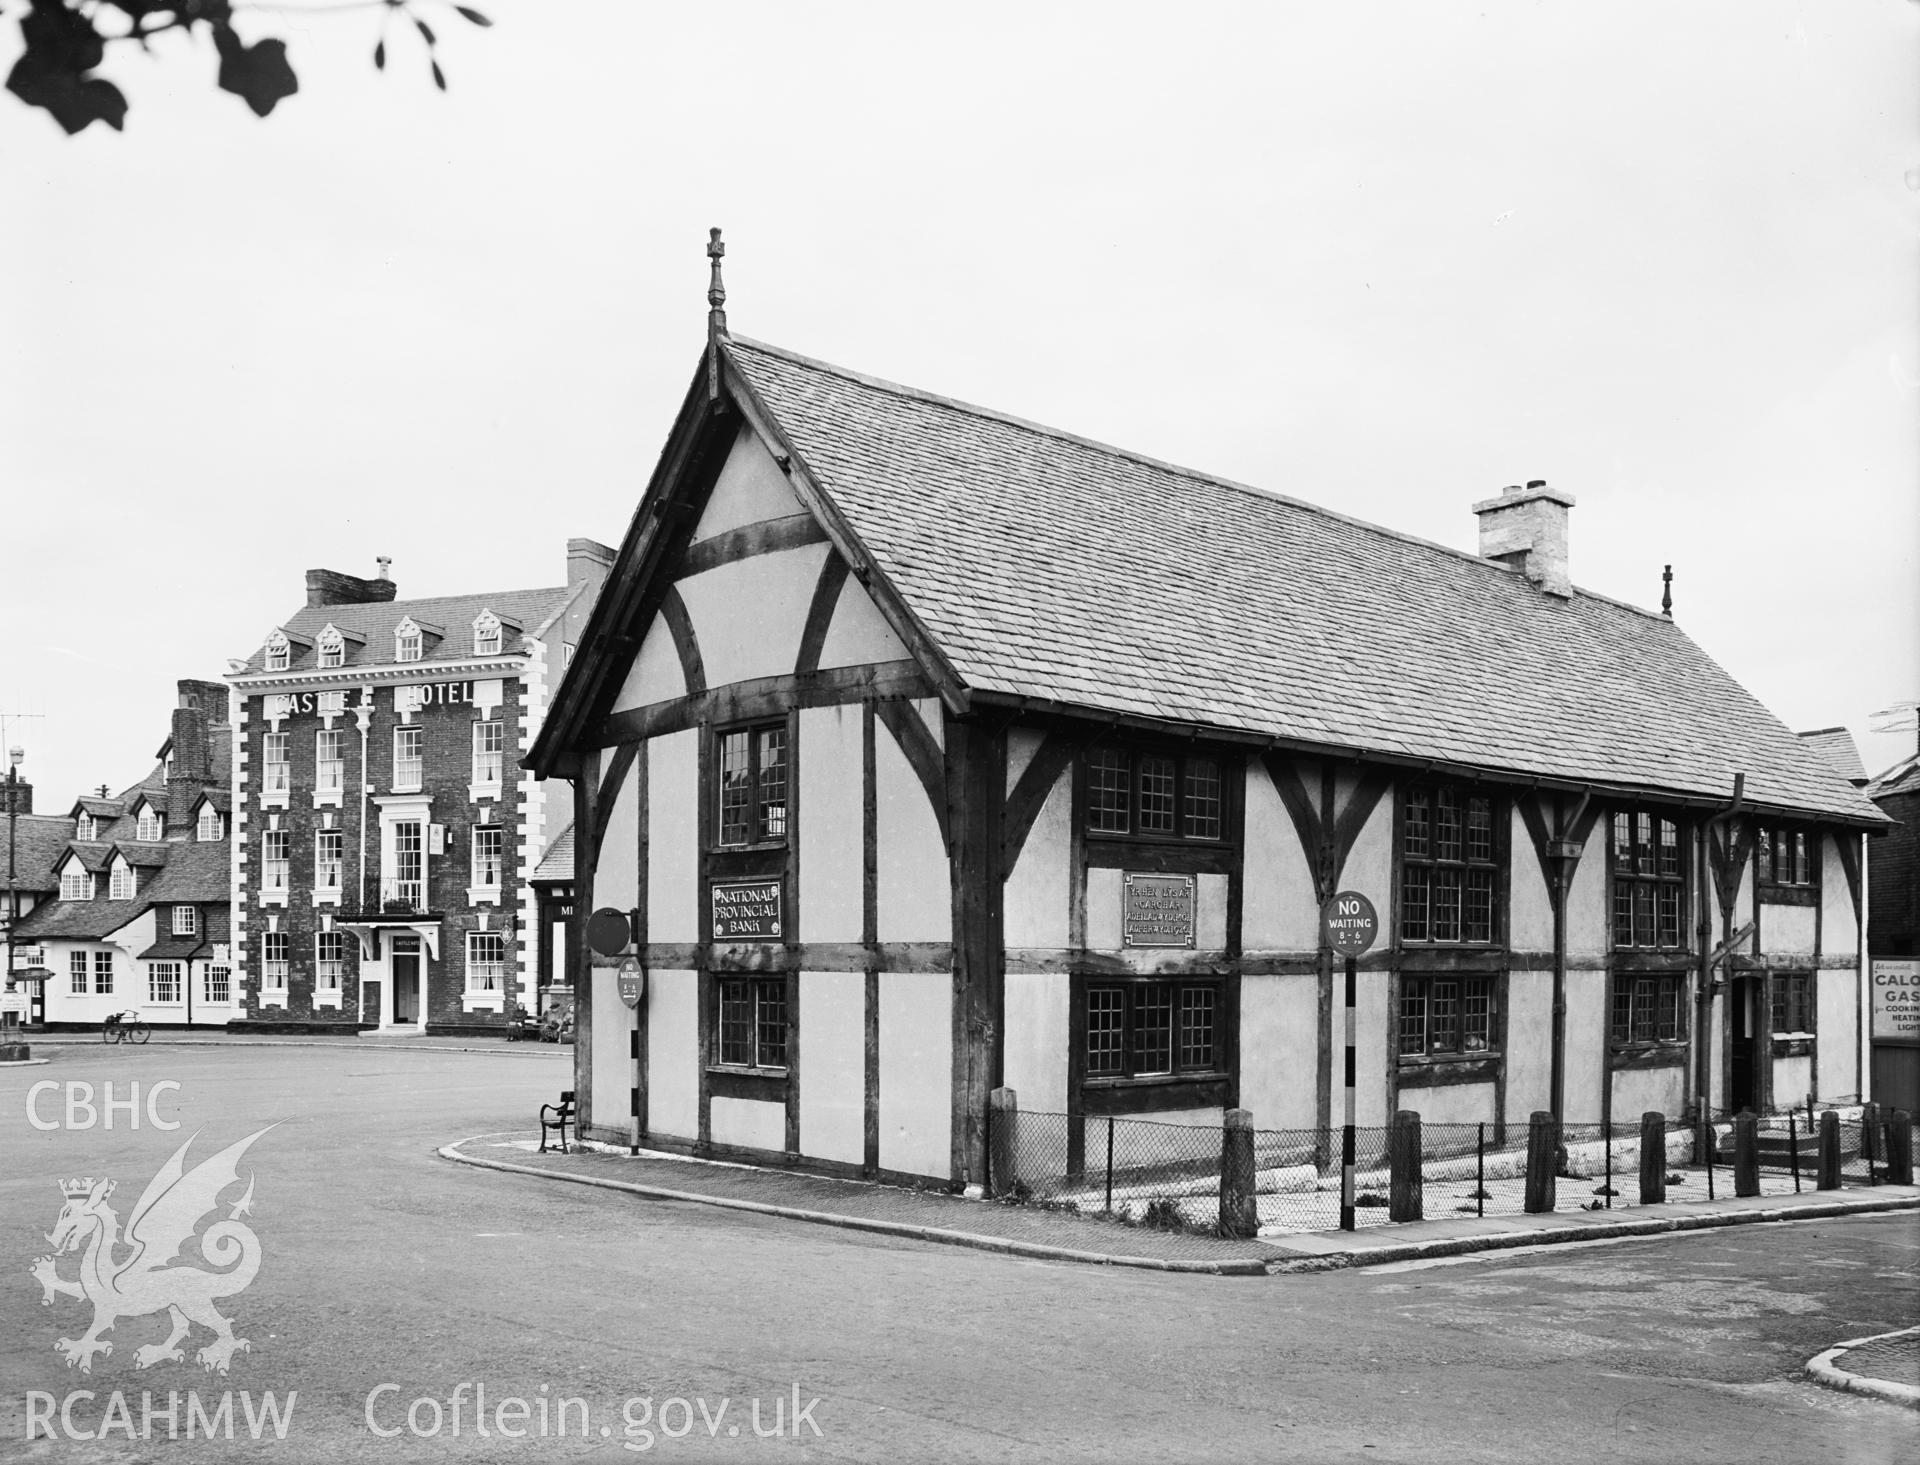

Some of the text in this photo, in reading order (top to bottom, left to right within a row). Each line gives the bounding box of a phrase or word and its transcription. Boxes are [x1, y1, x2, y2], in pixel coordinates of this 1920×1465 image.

[407, 681, 473, 705] HOTEL
[721, 890, 773, 903] NATIONAL
[715, 904, 777, 919] PROVINCIAL
[1339, 900, 1360, 915] NO
[730, 920, 760, 933] BANK
[1329, 918, 1371, 928] WAITING
[1340, 931, 1345, 939] 8
[1355, 931, 1361, 939] 6
[1885, 990, 1920, 1002] GAS
